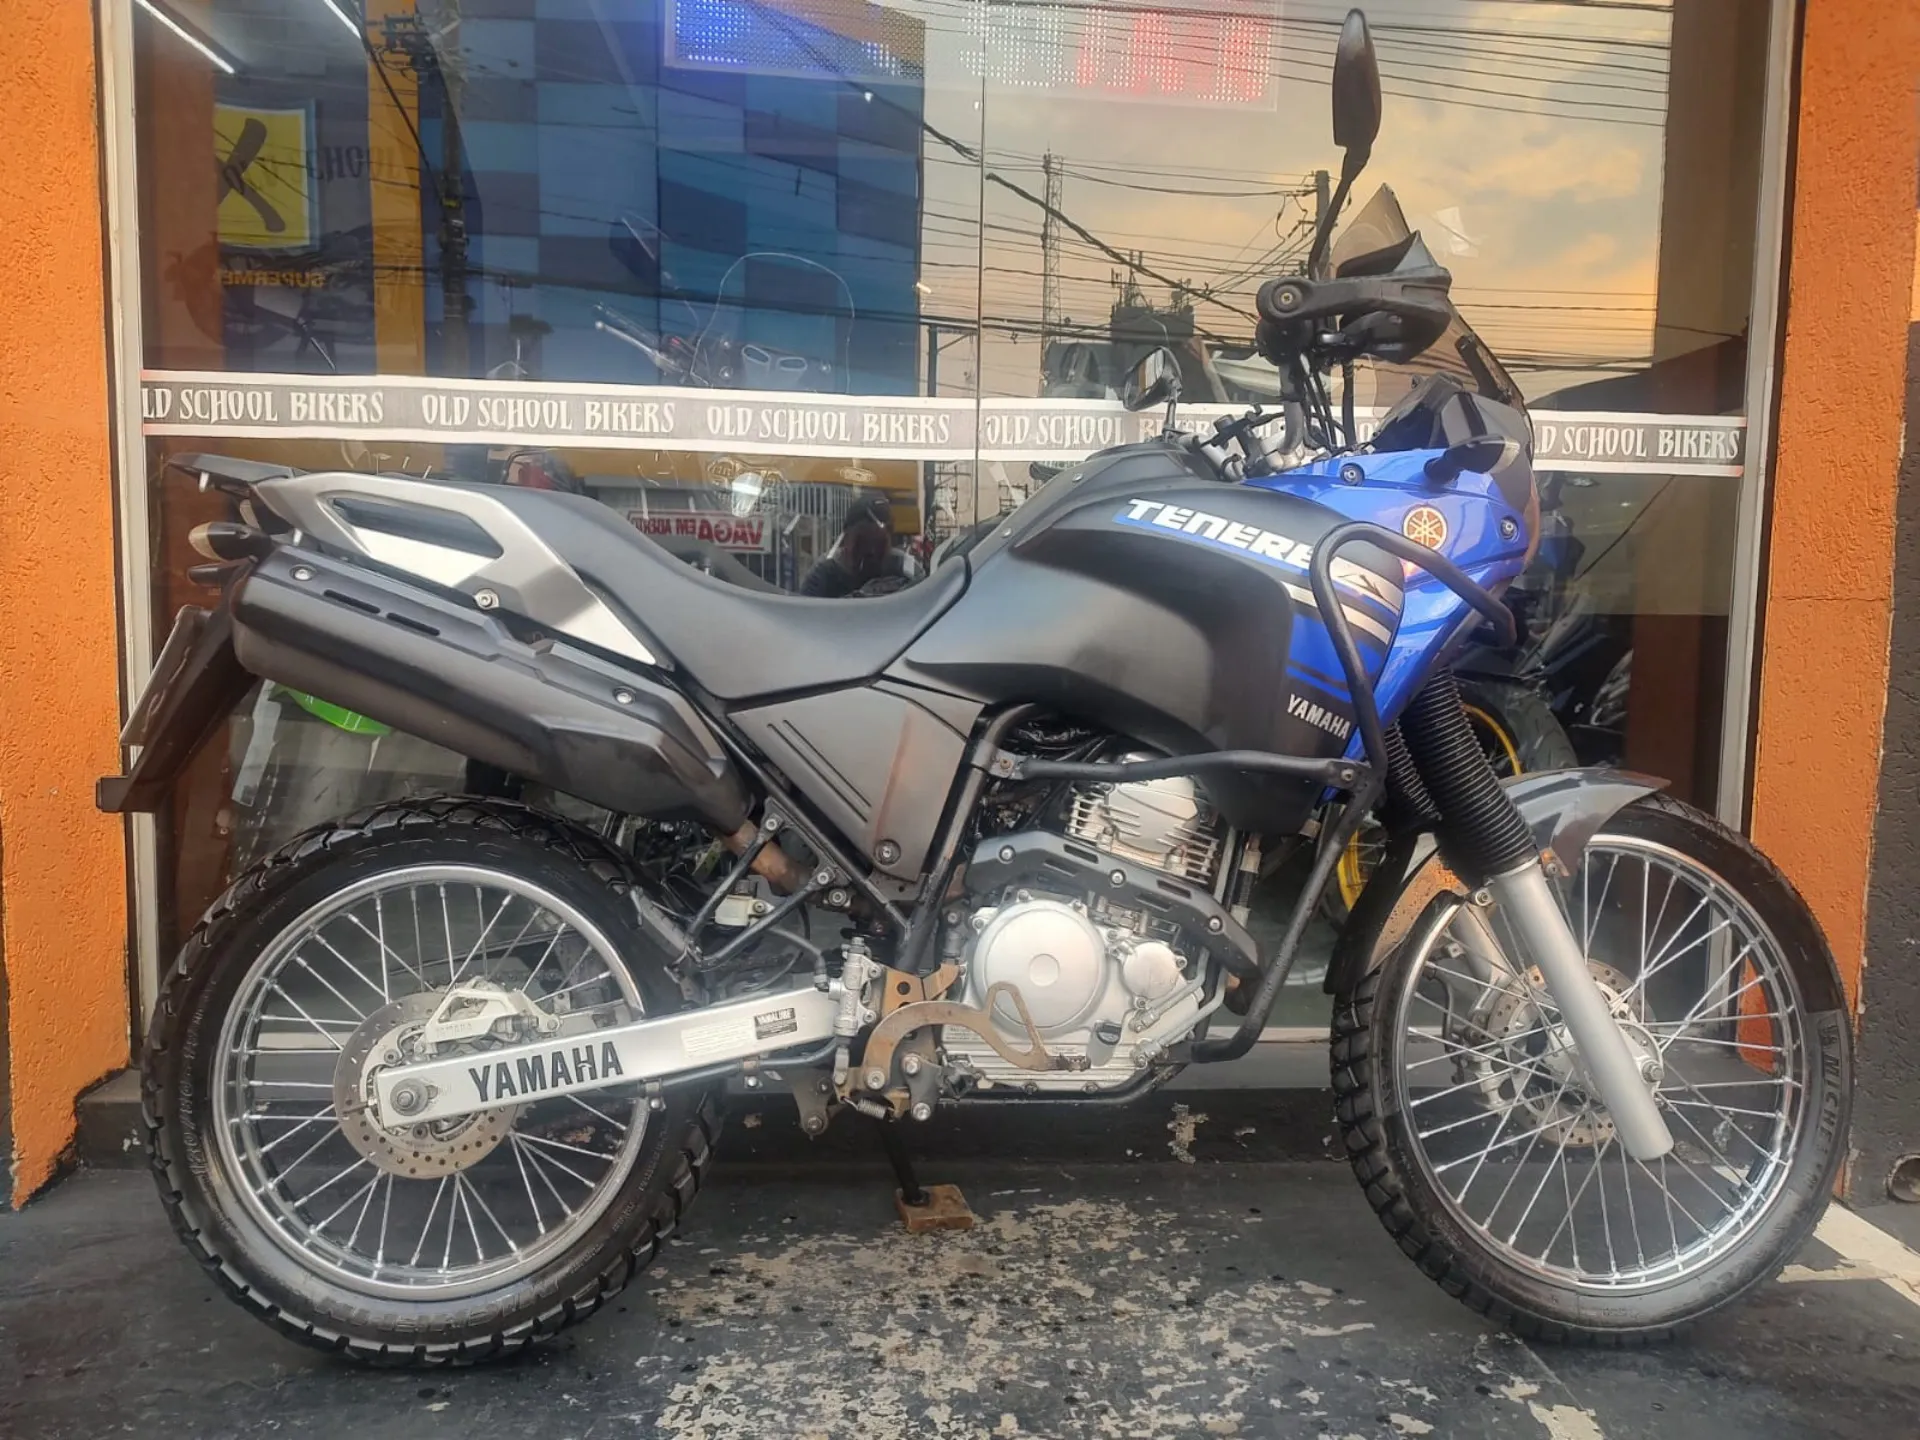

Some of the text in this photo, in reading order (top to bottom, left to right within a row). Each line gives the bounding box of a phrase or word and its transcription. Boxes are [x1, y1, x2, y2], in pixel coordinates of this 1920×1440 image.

[141, 388, 384, 424] LD SCHOOL BIKERS
[421, 394, 676, 433] OLD SCHOOL BIKERS
[706, 405, 950, 444] OLD SCHOOL BIKERS
[986, 415, 1030, 446] OLD
[1036, 415, 1126, 449] SCHOOL
[1562, 427, 1647, 459] SCHOOL
[1658, 429, 1740, 459] BIKERS
[1287, 693, 1351, 740] YAMAHA
[468, 1041, 624, 1103] YAMAHA
